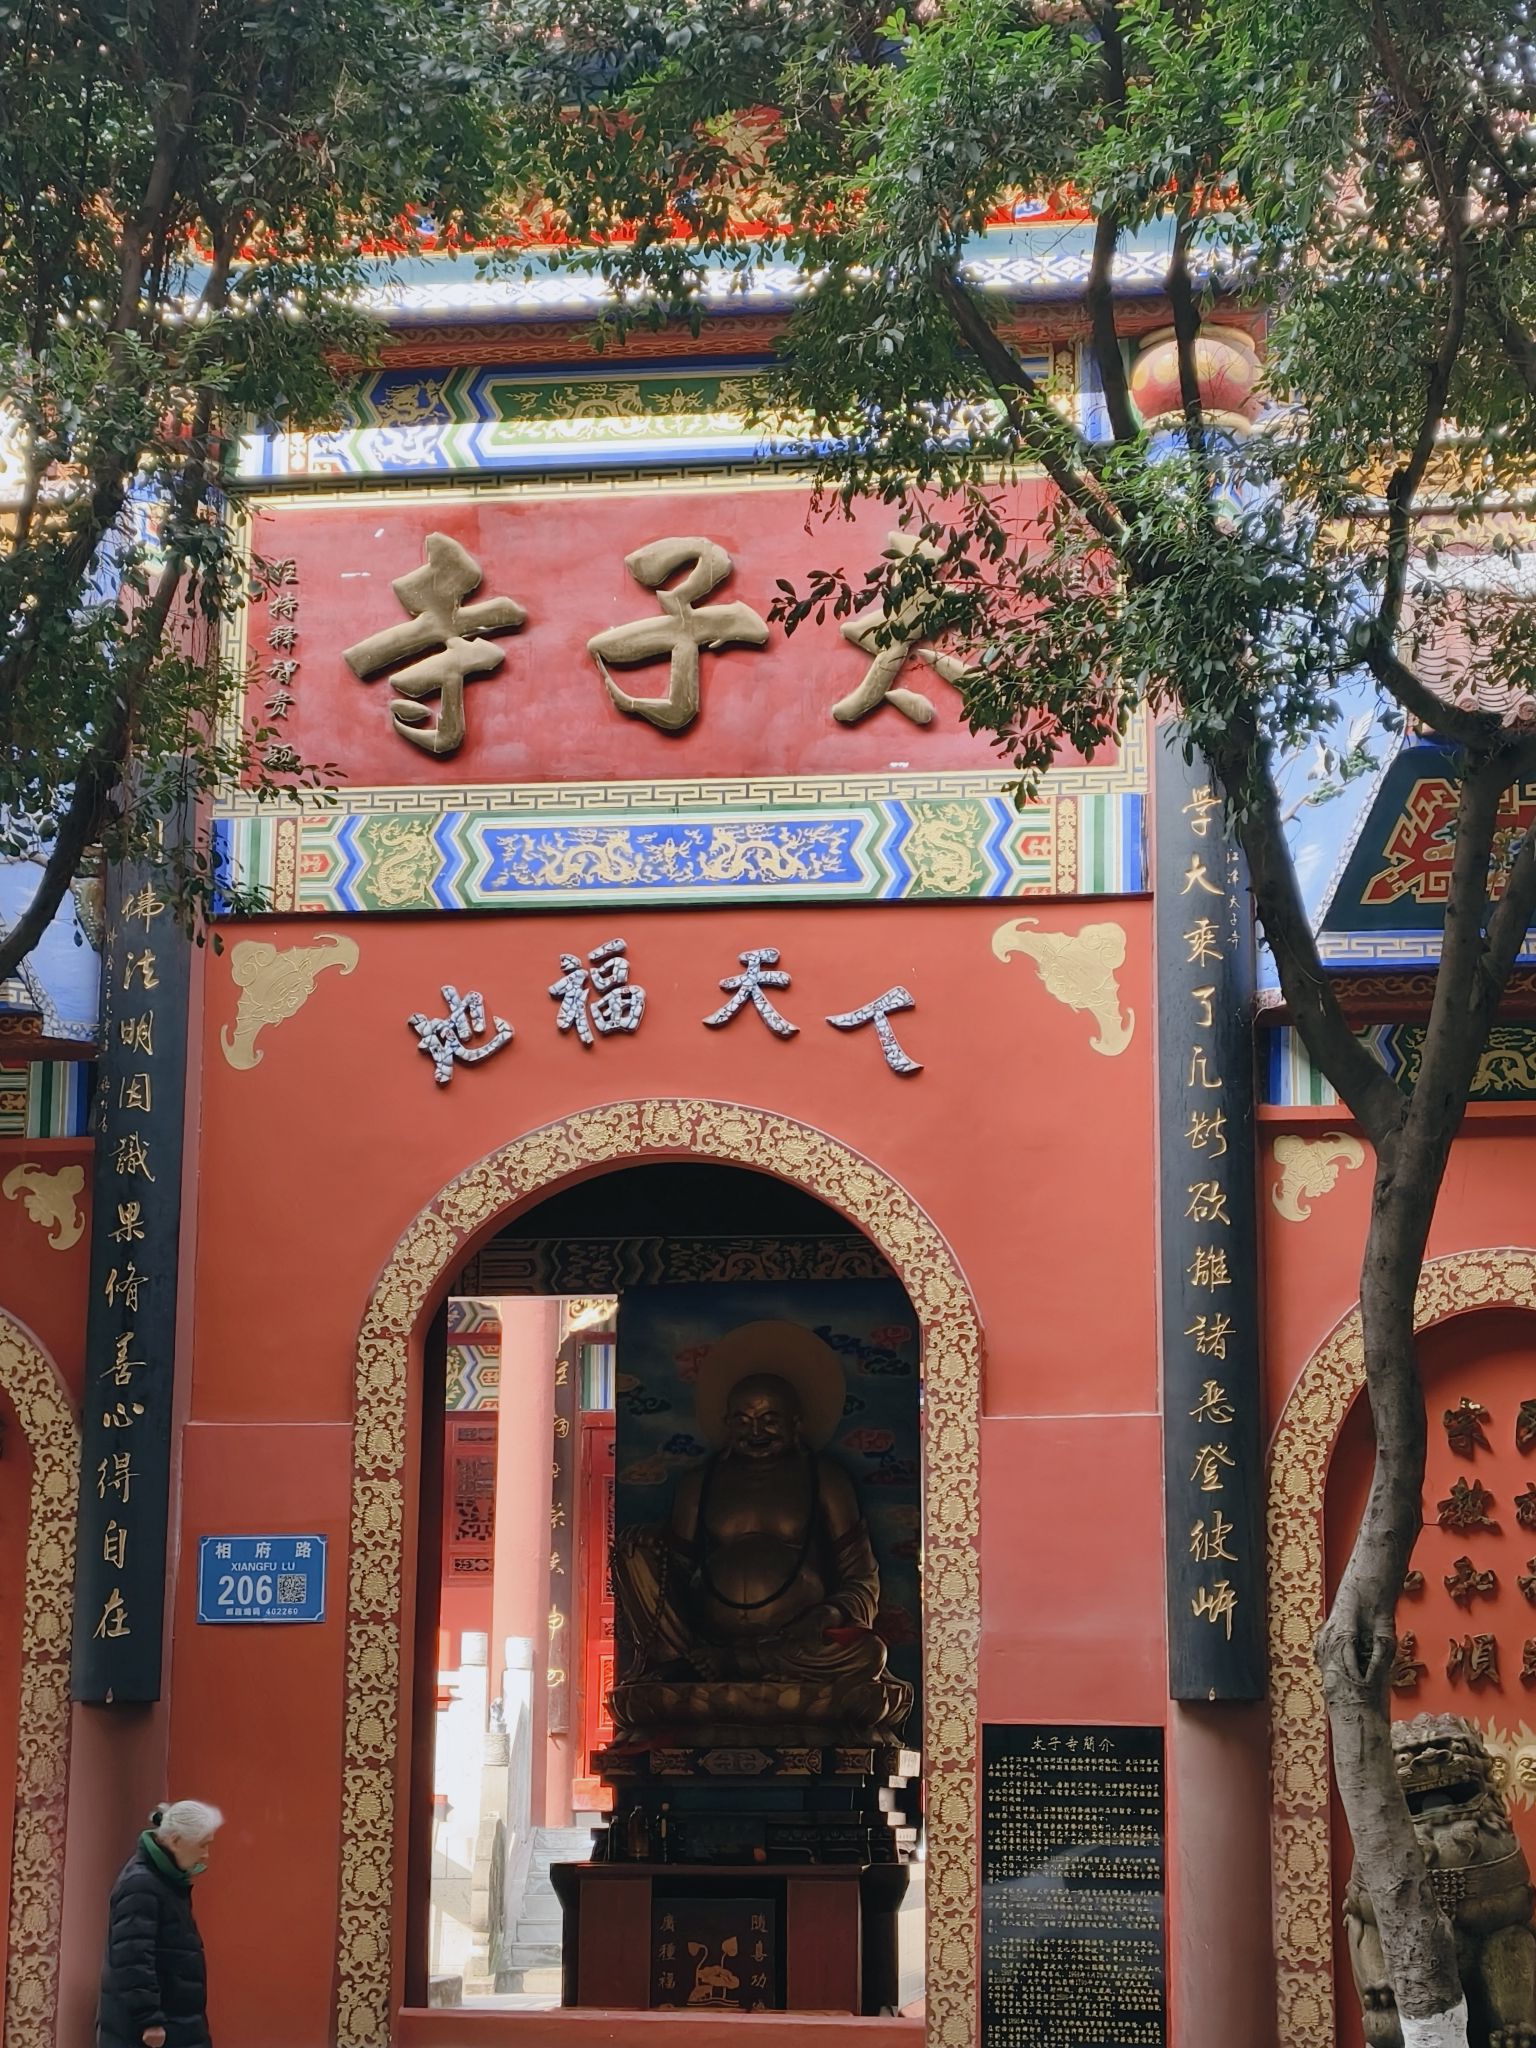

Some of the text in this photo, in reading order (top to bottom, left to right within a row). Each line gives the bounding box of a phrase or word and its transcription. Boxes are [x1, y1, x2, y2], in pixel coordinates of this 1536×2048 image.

[408, 937, 924, 1088] 人天福地
[215, 1542, 312, 1559] 相府路
[231, 1562, 295, 1571] XIANGFU LU
[218, 1575, 272, 1605] 206
[265, 1607, 298, 1615] 402260
